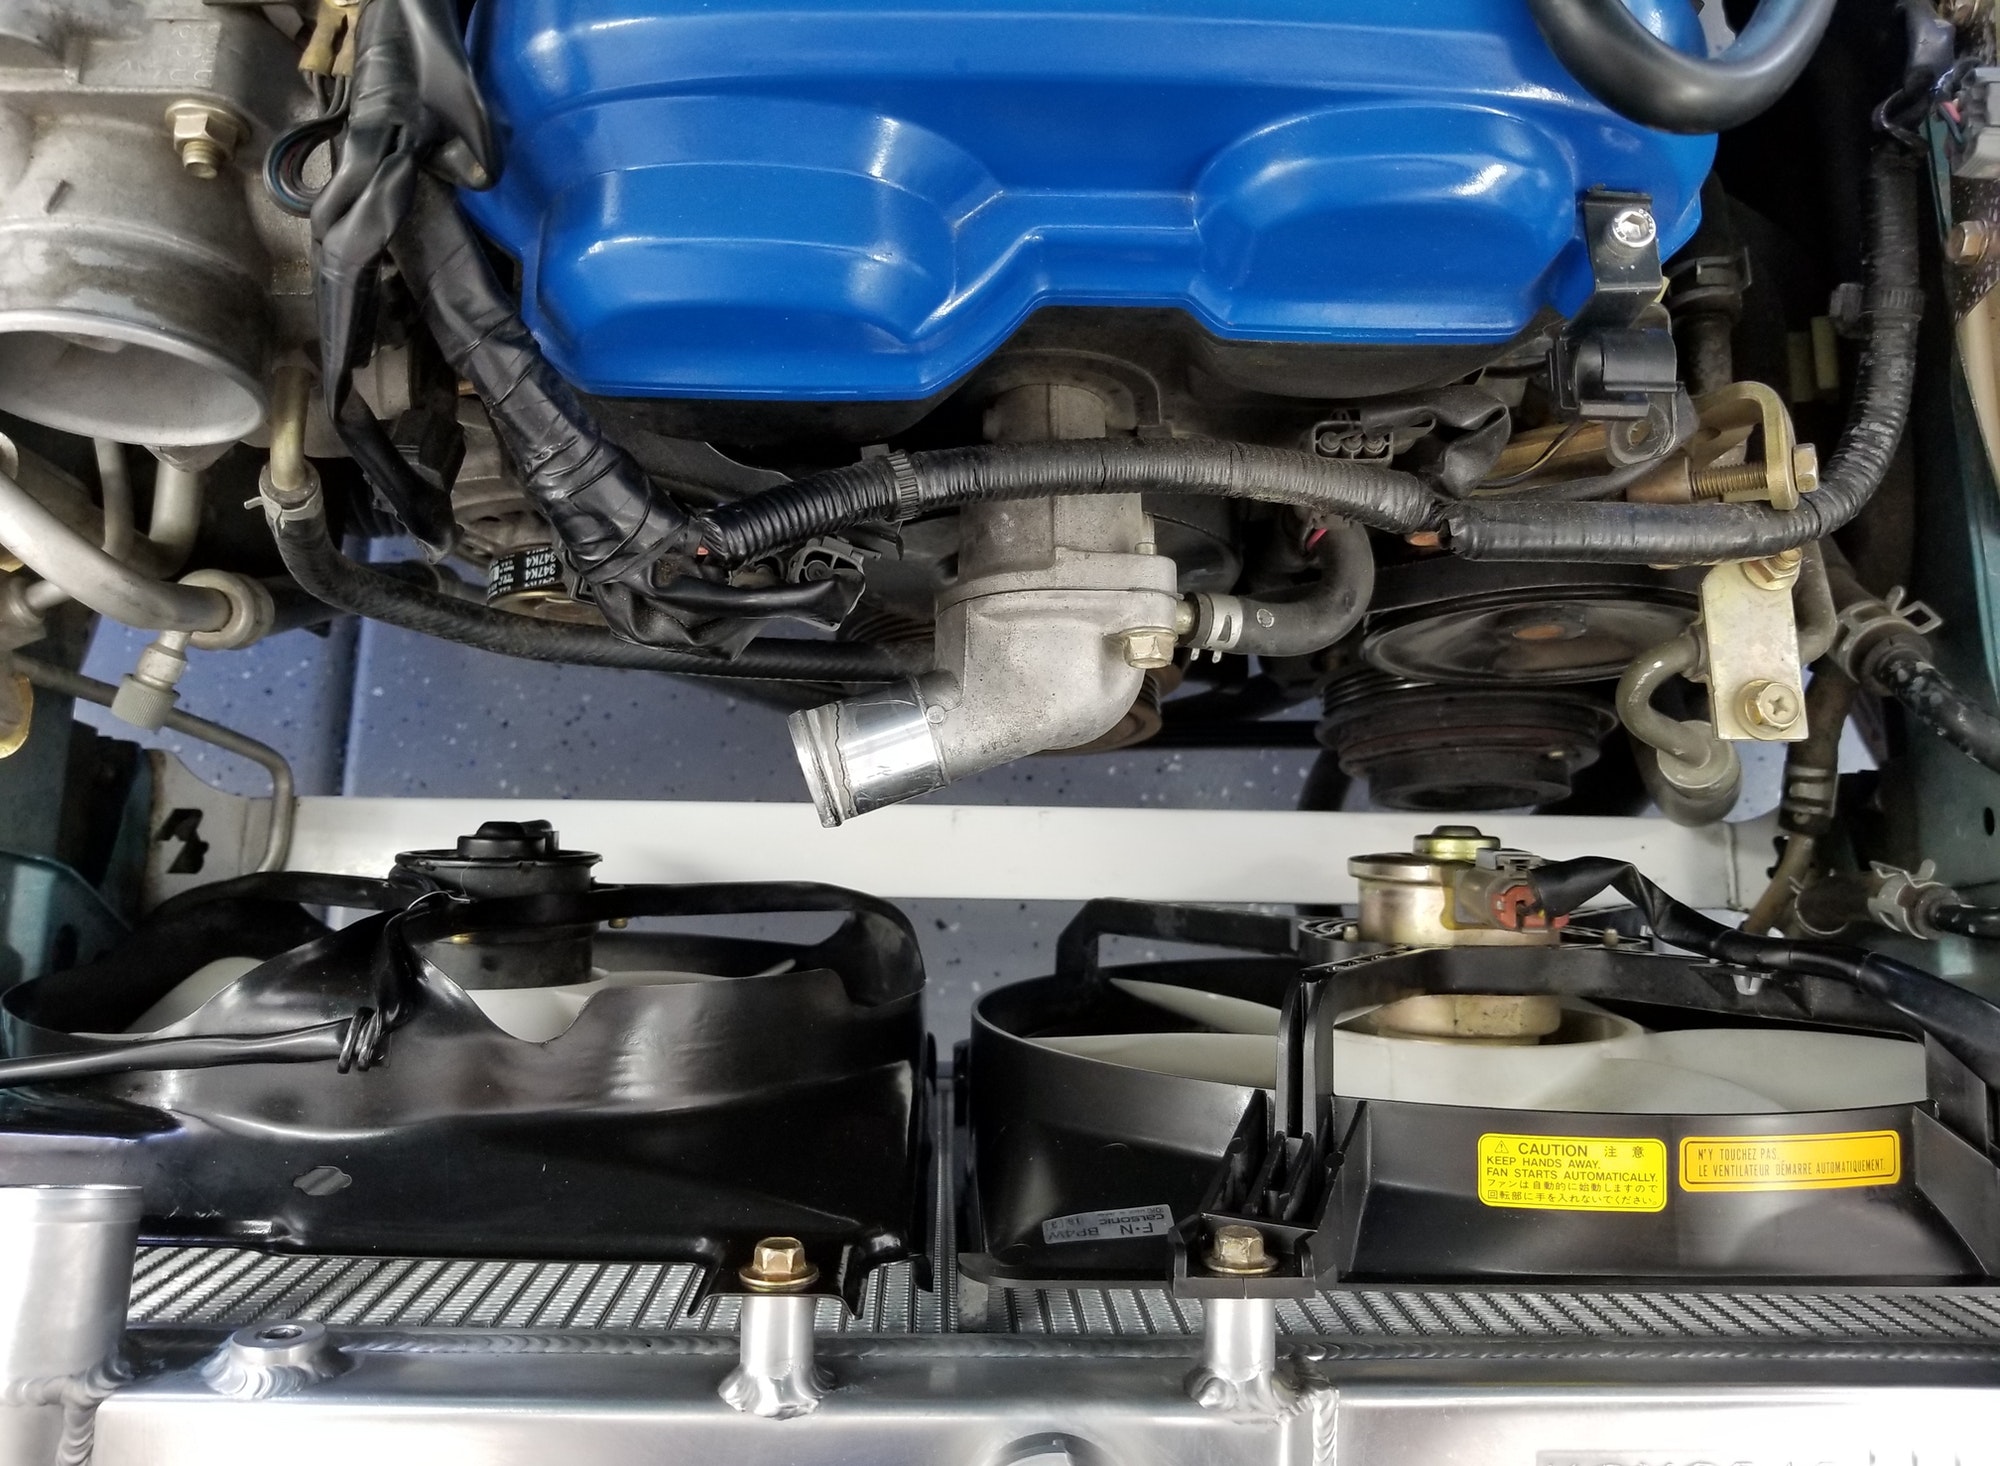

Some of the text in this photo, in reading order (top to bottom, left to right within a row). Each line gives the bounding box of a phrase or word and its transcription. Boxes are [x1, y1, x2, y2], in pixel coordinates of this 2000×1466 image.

[525, 564, 556, 581] 347K4
[1518, 1142, 1588, 1157] CAUTION
[1720, 1147, 1757, 1160] TOUCHEZ
[1760, 1147, 1780, 1160] PAS.
[1486, 1156, 1601, 1170] KEEP HANDS AWAY.
[1698, 1158, 1886, 1177] LE VENTILATEUR DÉMARRE AUTOMATIQUEMENT.
[1486, 1167, 1658, 1183] FAN STARTS AUTOMATICALLY.
